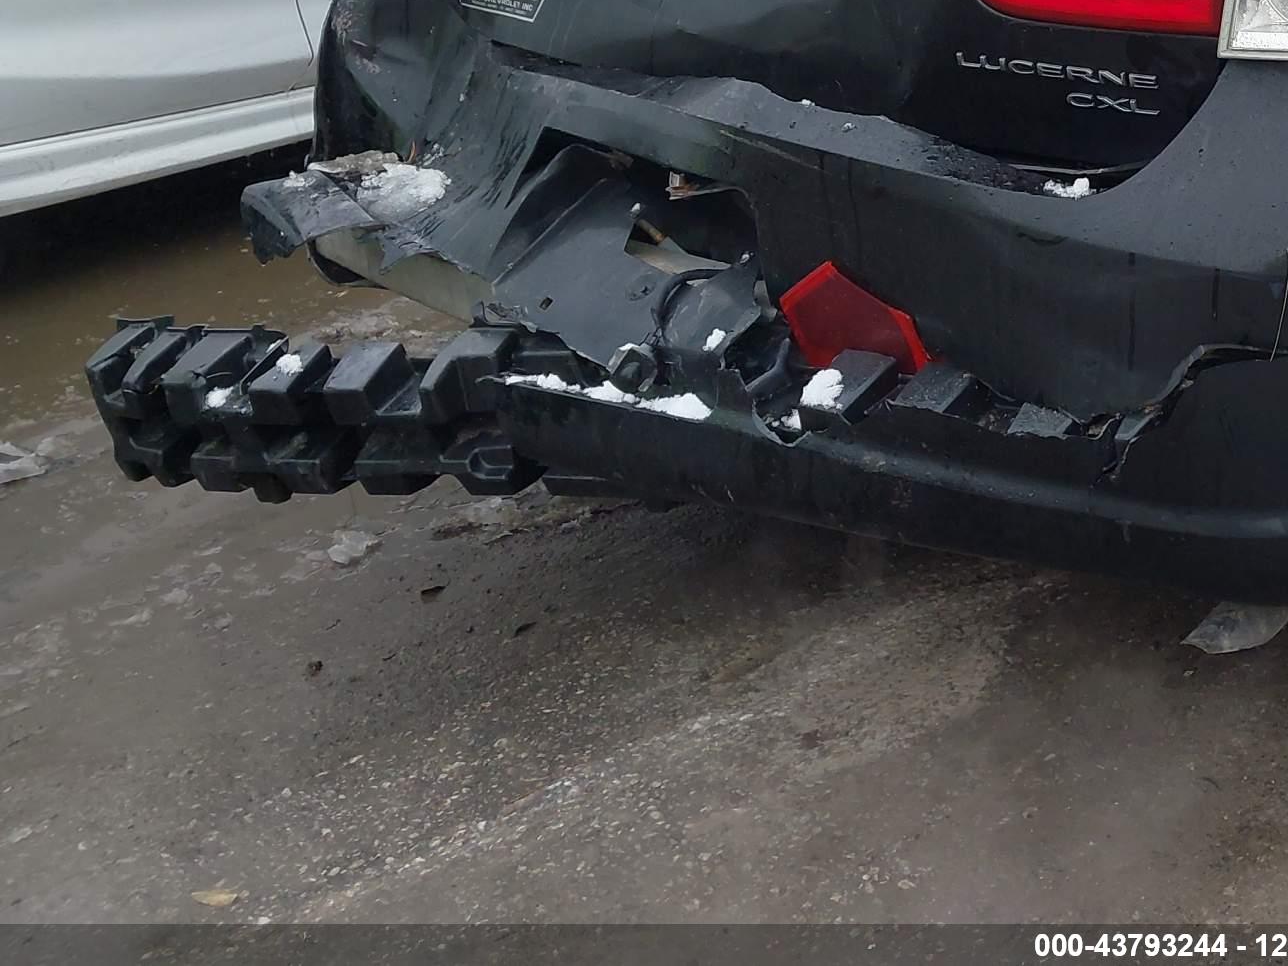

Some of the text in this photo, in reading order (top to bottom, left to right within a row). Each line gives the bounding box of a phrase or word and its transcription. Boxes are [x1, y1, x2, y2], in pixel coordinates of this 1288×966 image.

[521, 2, 534, 12] INC
[956, 52, 1159, 89] LUCERNE
[1066, 92, 1160, 115] CXL
